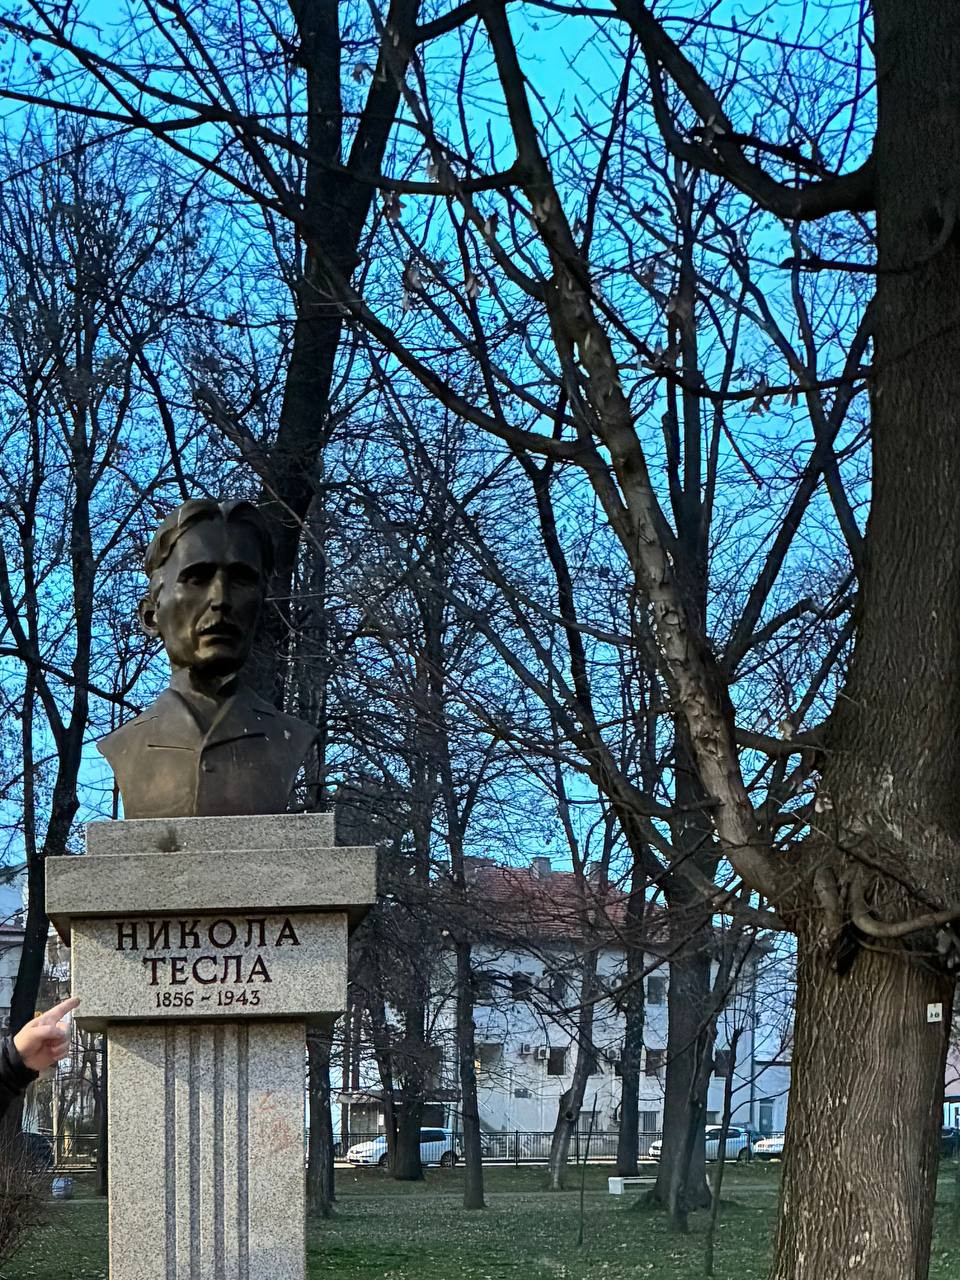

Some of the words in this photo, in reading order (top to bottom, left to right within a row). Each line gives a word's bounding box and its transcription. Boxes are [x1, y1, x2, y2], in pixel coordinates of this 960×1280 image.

[115, 917, 301, 951] НИКОЛА
[142, 954, 273, 987] ТЕСЛА
[155, 991, 194, 1008] 1856
[217, 990, 261, 1007] 1943
